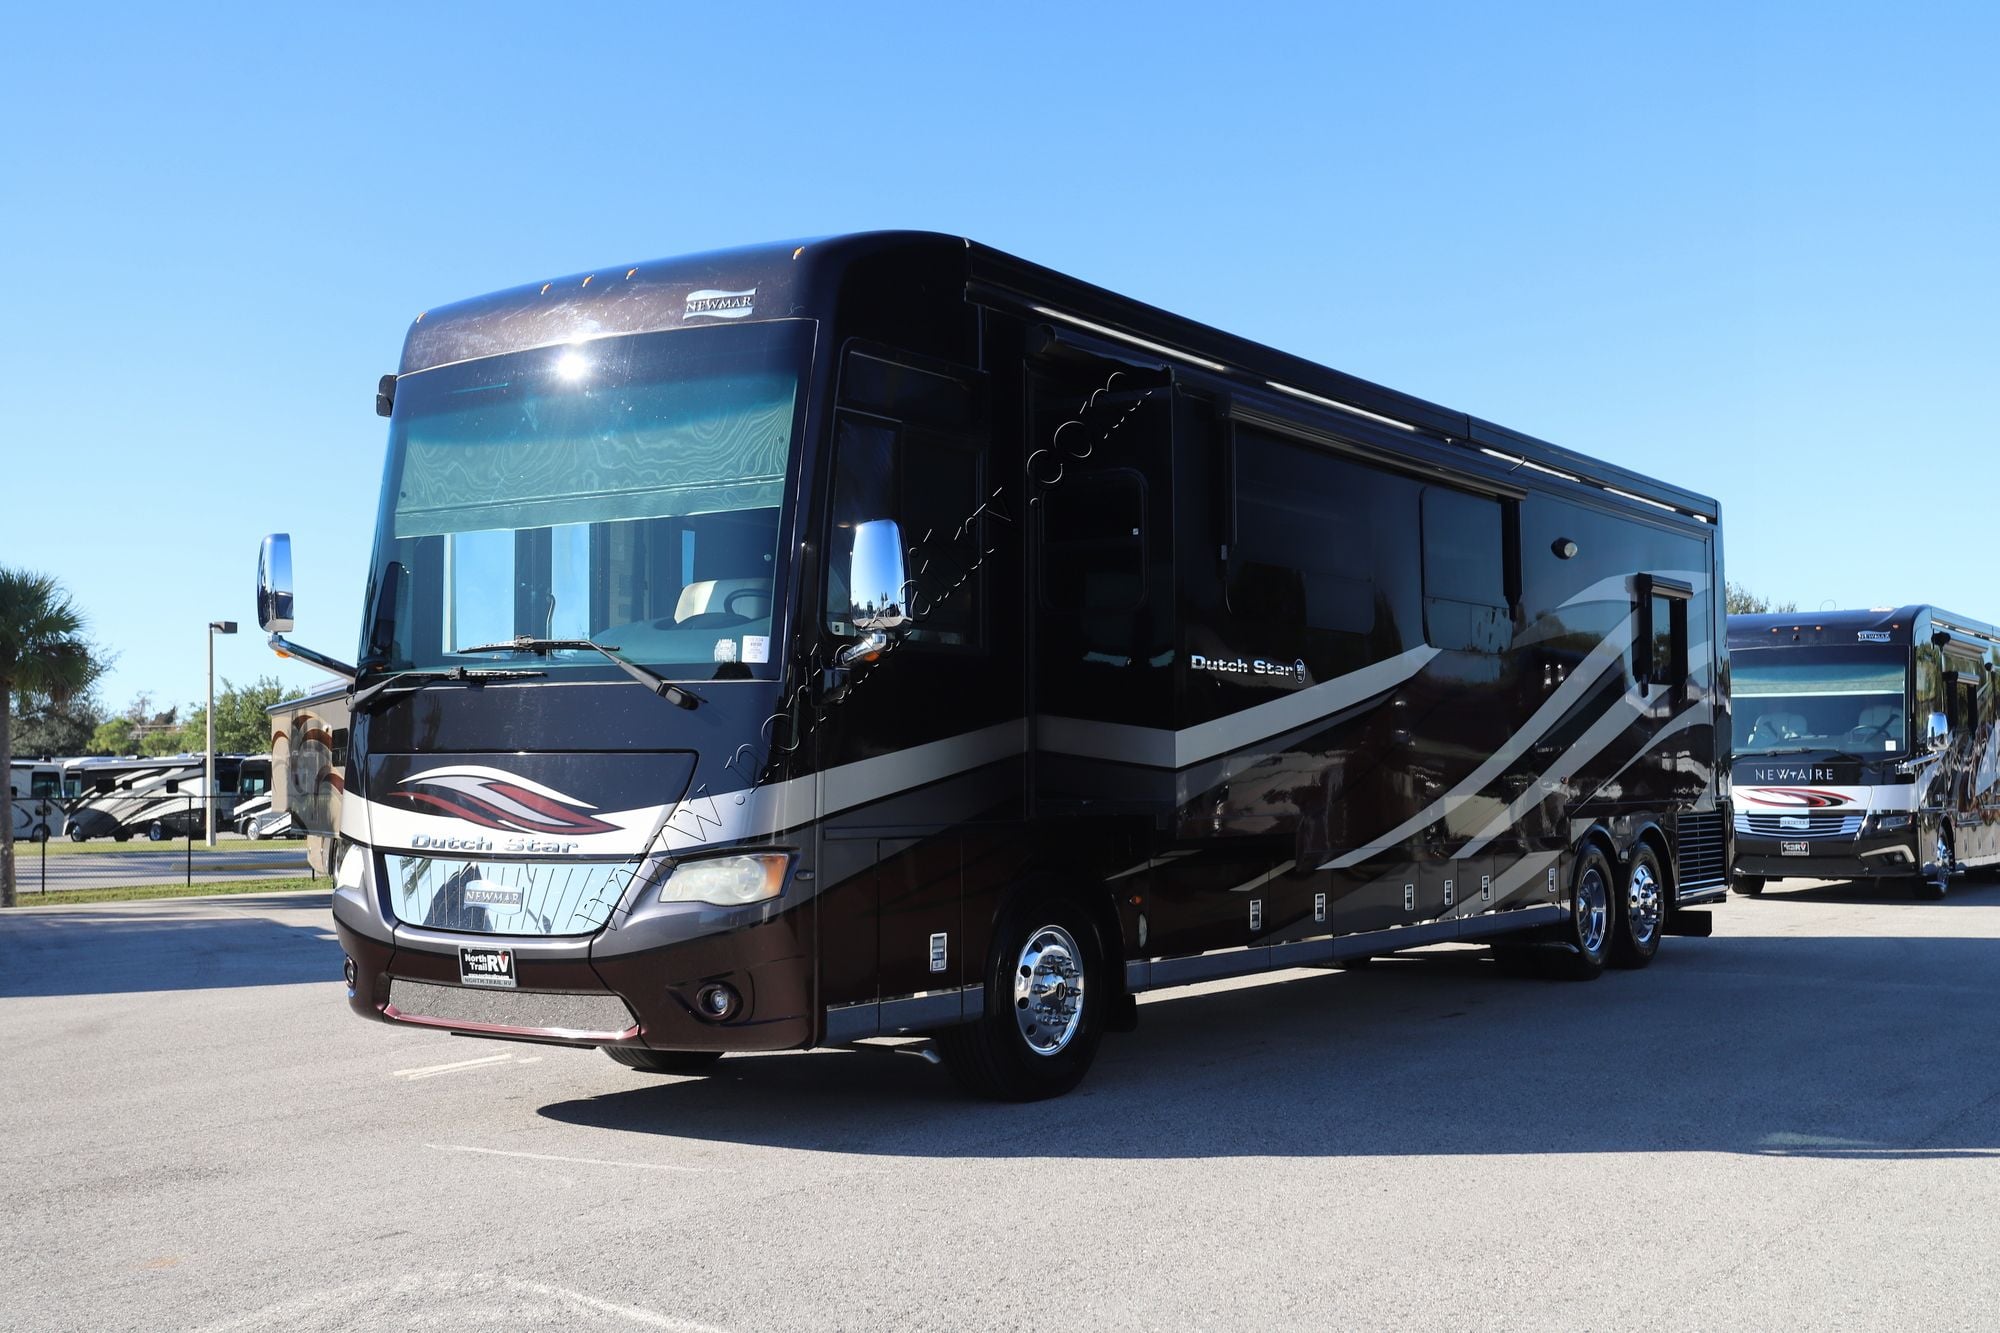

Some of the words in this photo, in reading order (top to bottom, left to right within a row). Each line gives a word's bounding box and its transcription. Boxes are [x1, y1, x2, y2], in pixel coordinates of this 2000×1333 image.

[686, 296, 753, 312] NEWMAR
[1191, 655, 1248, 673] Dutch
[1253, 660, 1293, 676] Star
[412, 834, 493, 851] Dutch
[504, 837, 579, 854] Star
[466, 891, 520, 902] NEWMAR
[465, 953, 487, 963] North
[487, 954, 509, 972] RV
[470, 962, 487, 971] Trail
